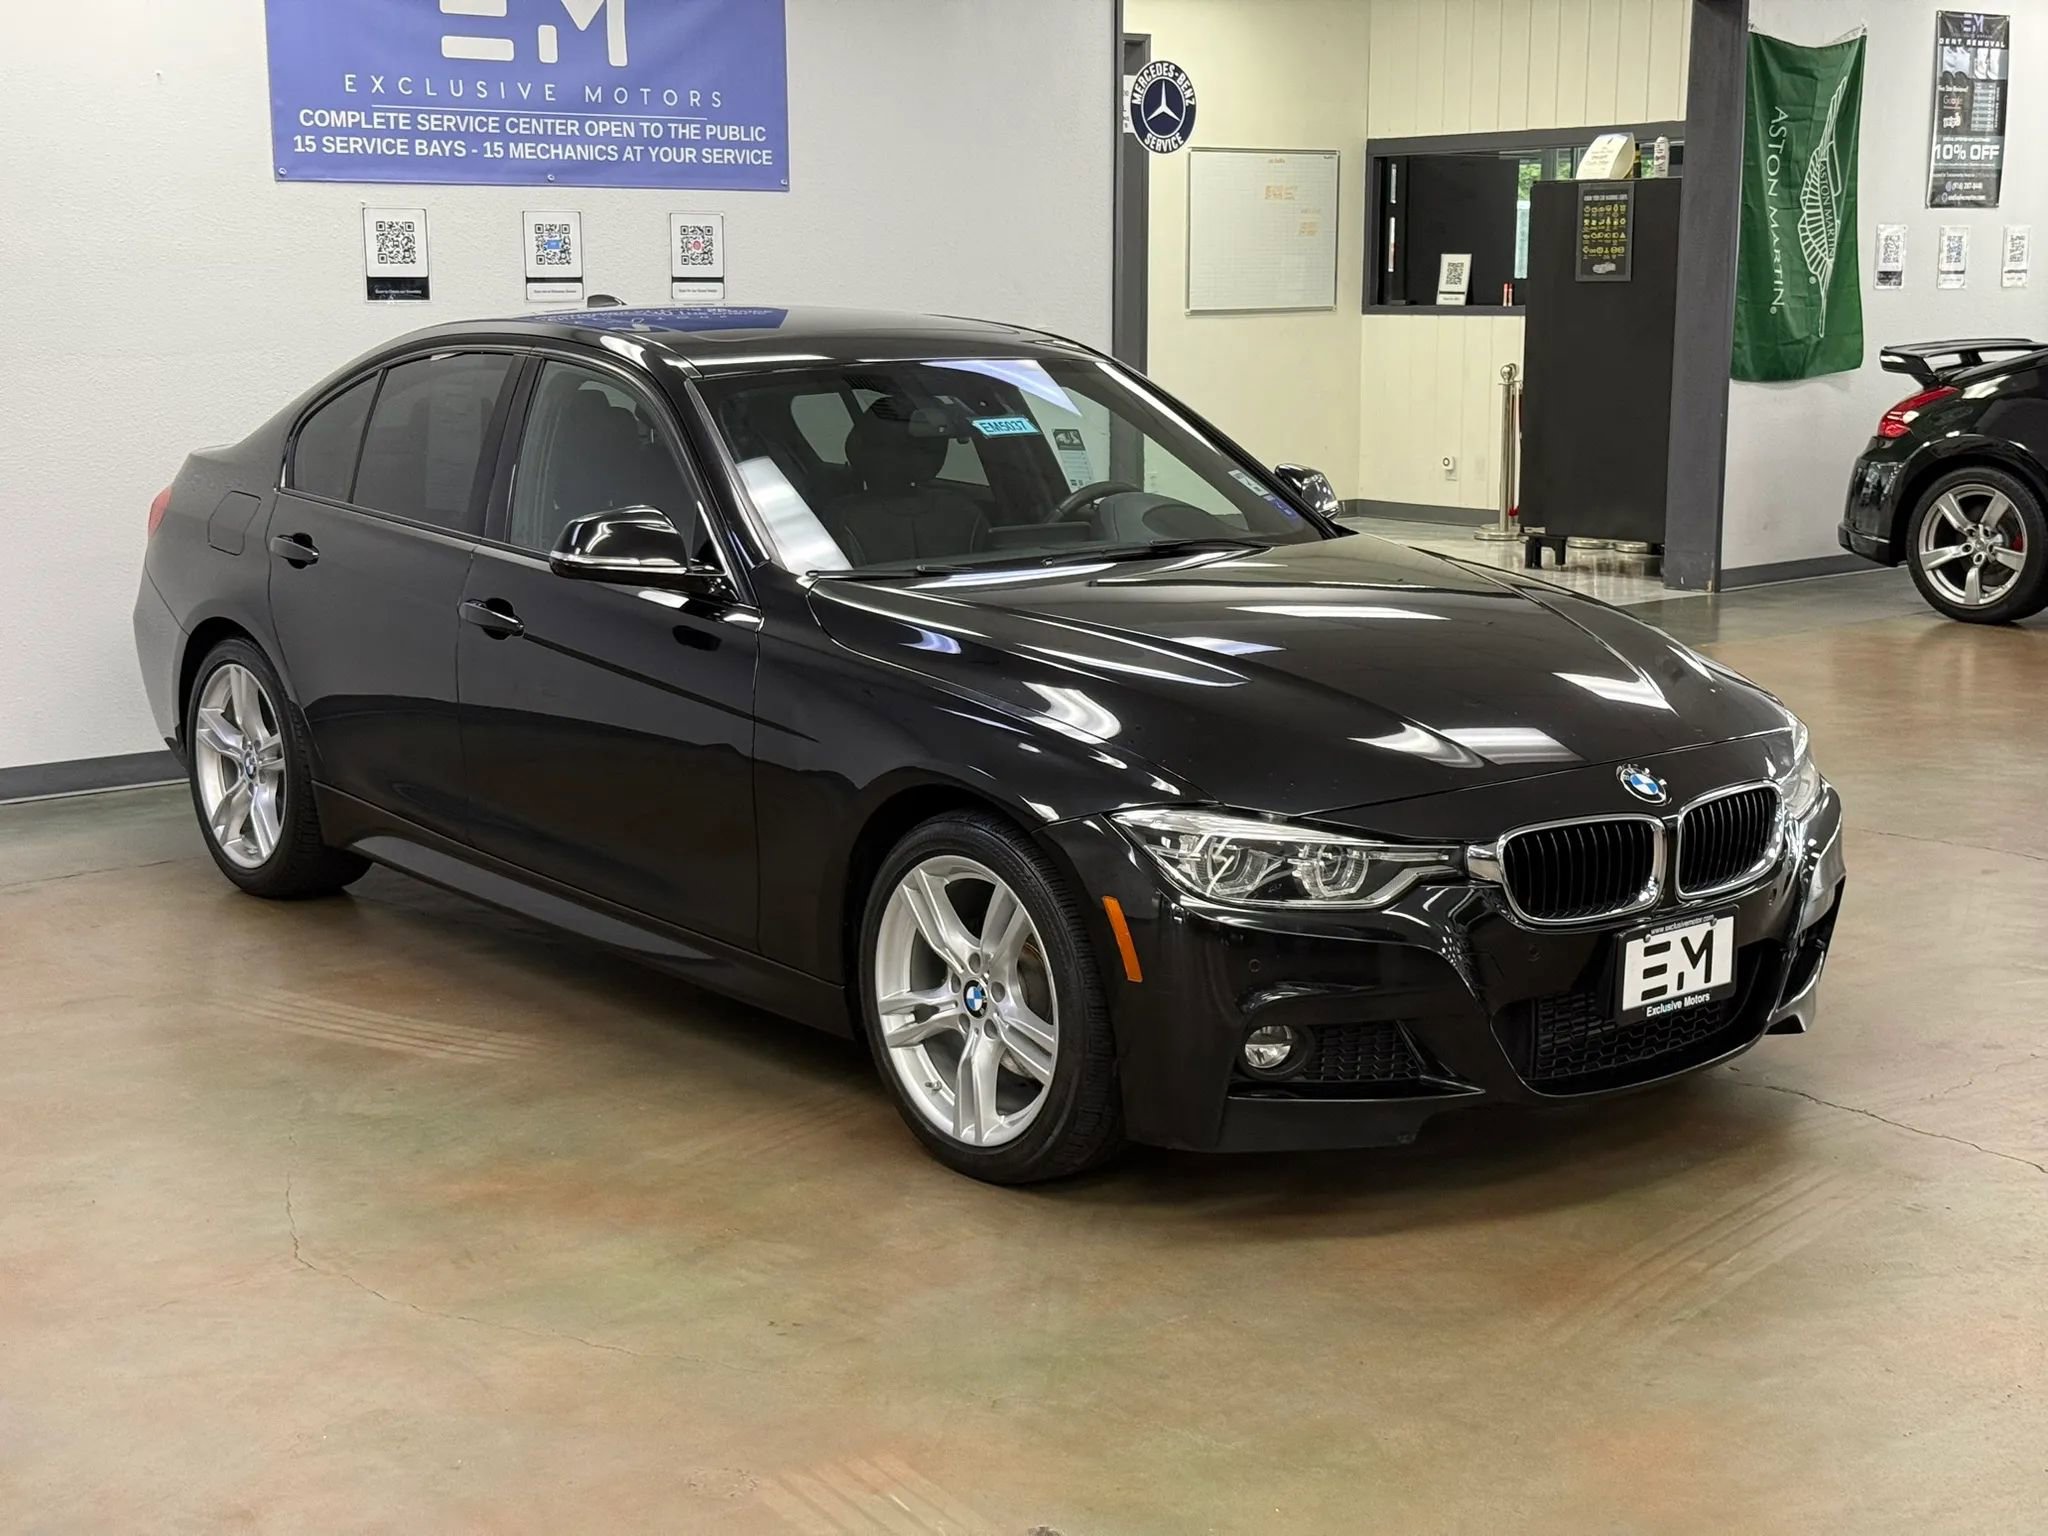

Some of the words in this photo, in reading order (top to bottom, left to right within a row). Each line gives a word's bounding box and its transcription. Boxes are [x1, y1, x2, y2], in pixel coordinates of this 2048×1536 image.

[344, 74, 557, 101] EXCLUSIVE
[585, 84, 722, 108] MOTORS
[1131, 62, 1196, 106] MERCEDES-BENZ
[299, 109, 411, 131] COMPLETE
[416, 114, 500, 133] SERVICE
[505, 117, 580, 136] CENTER
[584, 121, 636, 138] OPEN
[640, 122, 664, 139] TO
[668, 123, 701, 140] THE
[705, 125, 767, 142] PUBLIC
[1144, 132, 1184, 152] SERVICE
[293, 135, 317, 153] 15
[321, 136, 410, 156] SERVICE
[414, 139, 467, 157] BAYS
[483, 142, 504, 158] 15
[509, 143, 618, 162] MECHANICS
[622, 146, 645, 163] AT
[648, 146, 698, 164] YOUR
[701, 148, 774, 166] SERVICE
[1766, 106, 1788, 196] ASTON
[1935, 144, 1967, 160] 10%
[1970, 144, 2000, 160] OFF
[1820, 163, 1831, 205] ASTON
[1823, 208, 1836, 258] MARTIN
[1768, 206, 1785, 306] MARTIN
[979, 420, 1028, 433] EM5037
[1641, 929, 1714, 1001] EM
[1646, 999, 1682, 1017] Exclusive
[1683, 992, 1711, 1007] Motors
